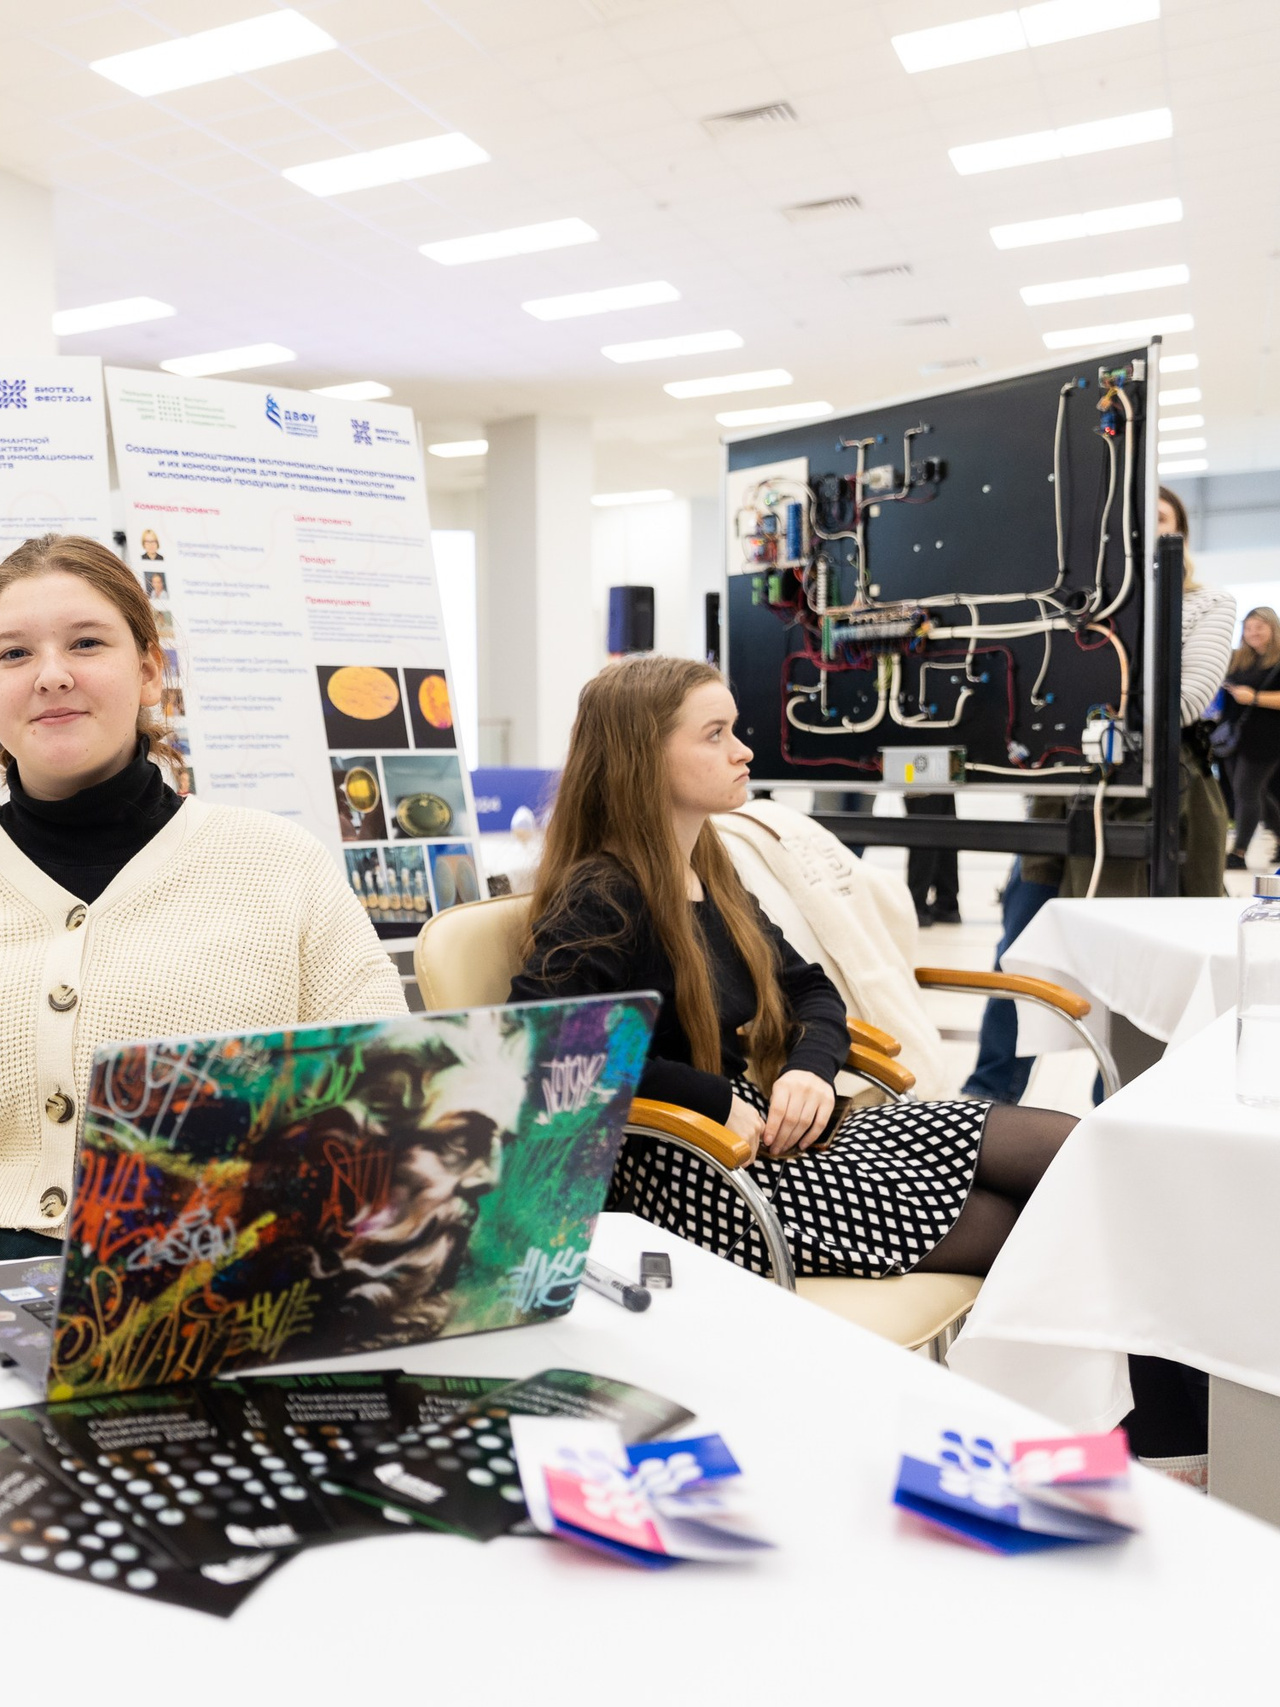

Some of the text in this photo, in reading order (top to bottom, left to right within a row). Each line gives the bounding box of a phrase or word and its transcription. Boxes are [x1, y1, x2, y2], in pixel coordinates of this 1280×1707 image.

[284, 410, 316, 424] ДВФУ
[7, 454, 94, 462] ИННОВАЦИОННЫХ
[125, 444, 416, 482] Создание моноштаммов молочнокислых микроорганизмов
